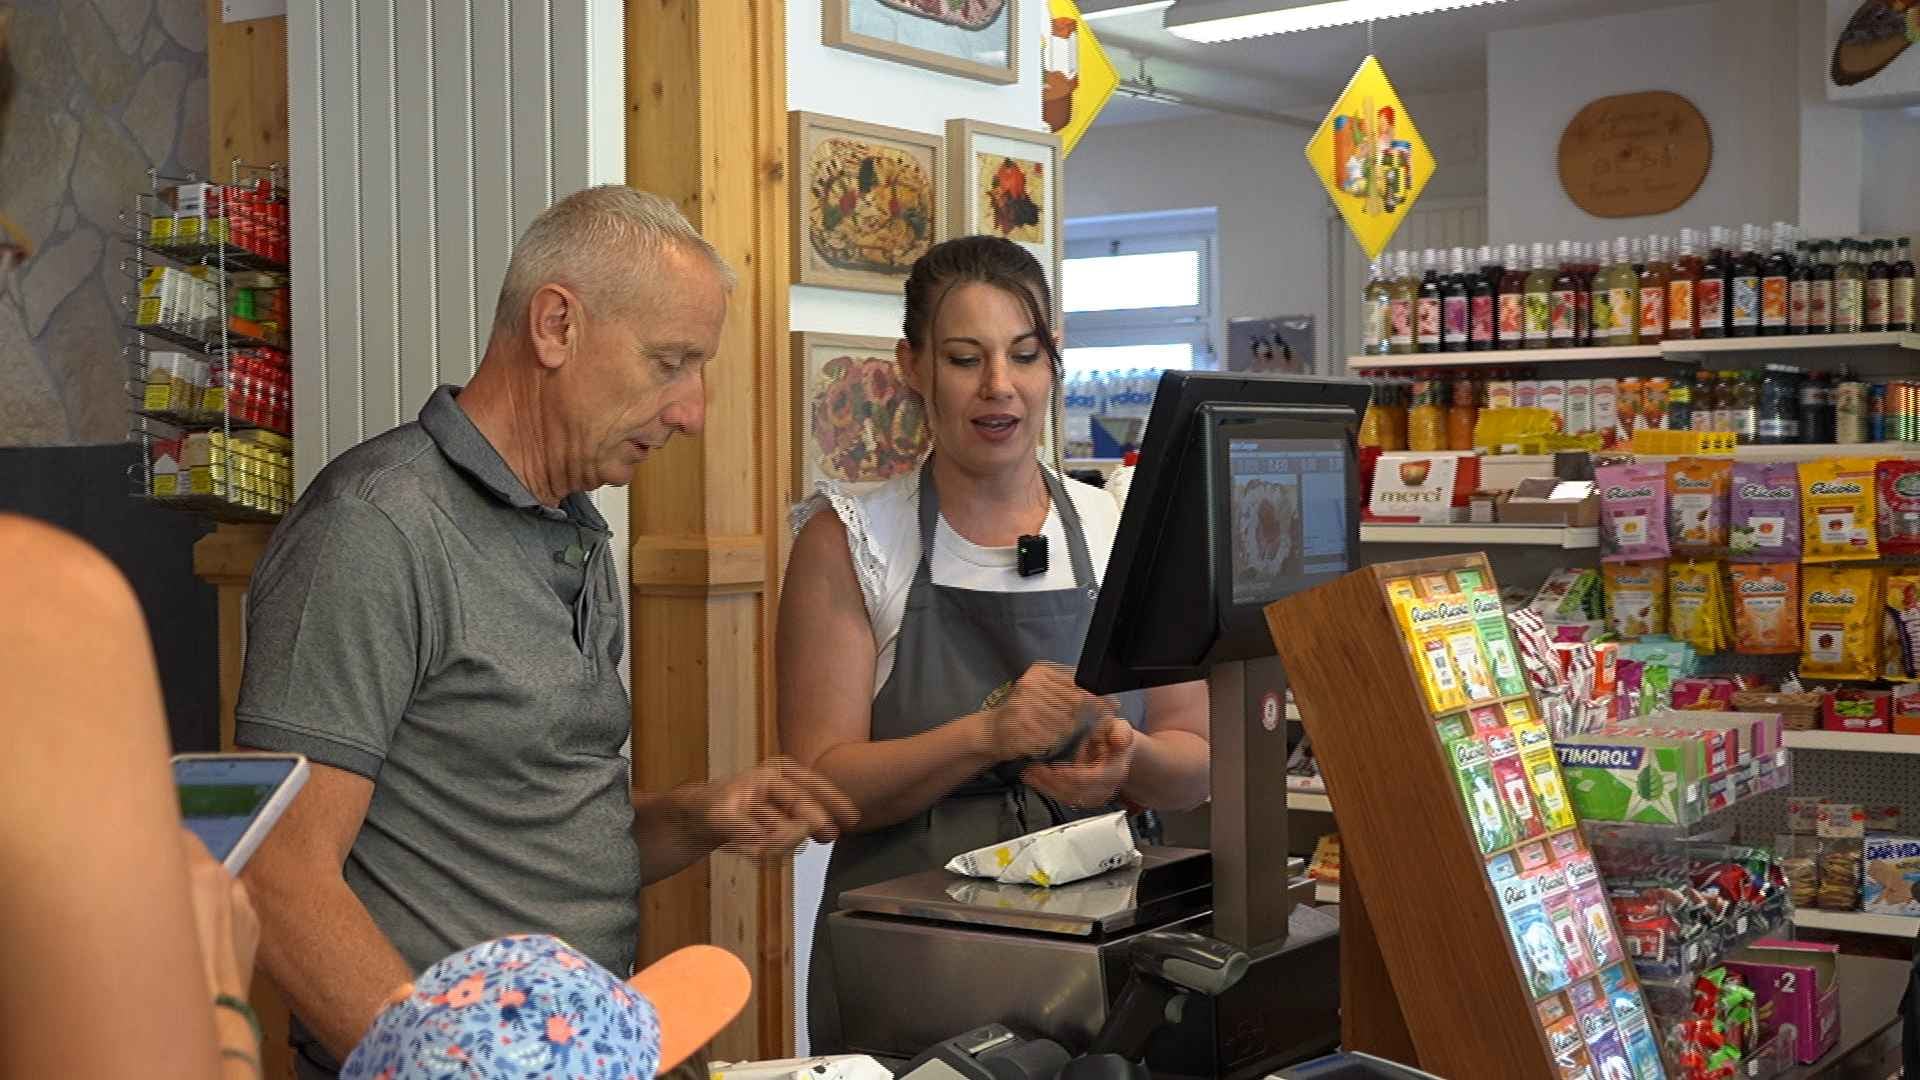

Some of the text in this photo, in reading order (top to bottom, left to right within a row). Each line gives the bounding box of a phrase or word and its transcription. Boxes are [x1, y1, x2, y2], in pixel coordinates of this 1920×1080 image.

[1380, 487, 1442, 502] merci
[1606, 487, 1651, 499] Ricola
[1742, 485, 1792, 498] Ricola
[1810, 482, 1861, 495] Ricola
[1560, 747, 1632, 766] TIMOROL
